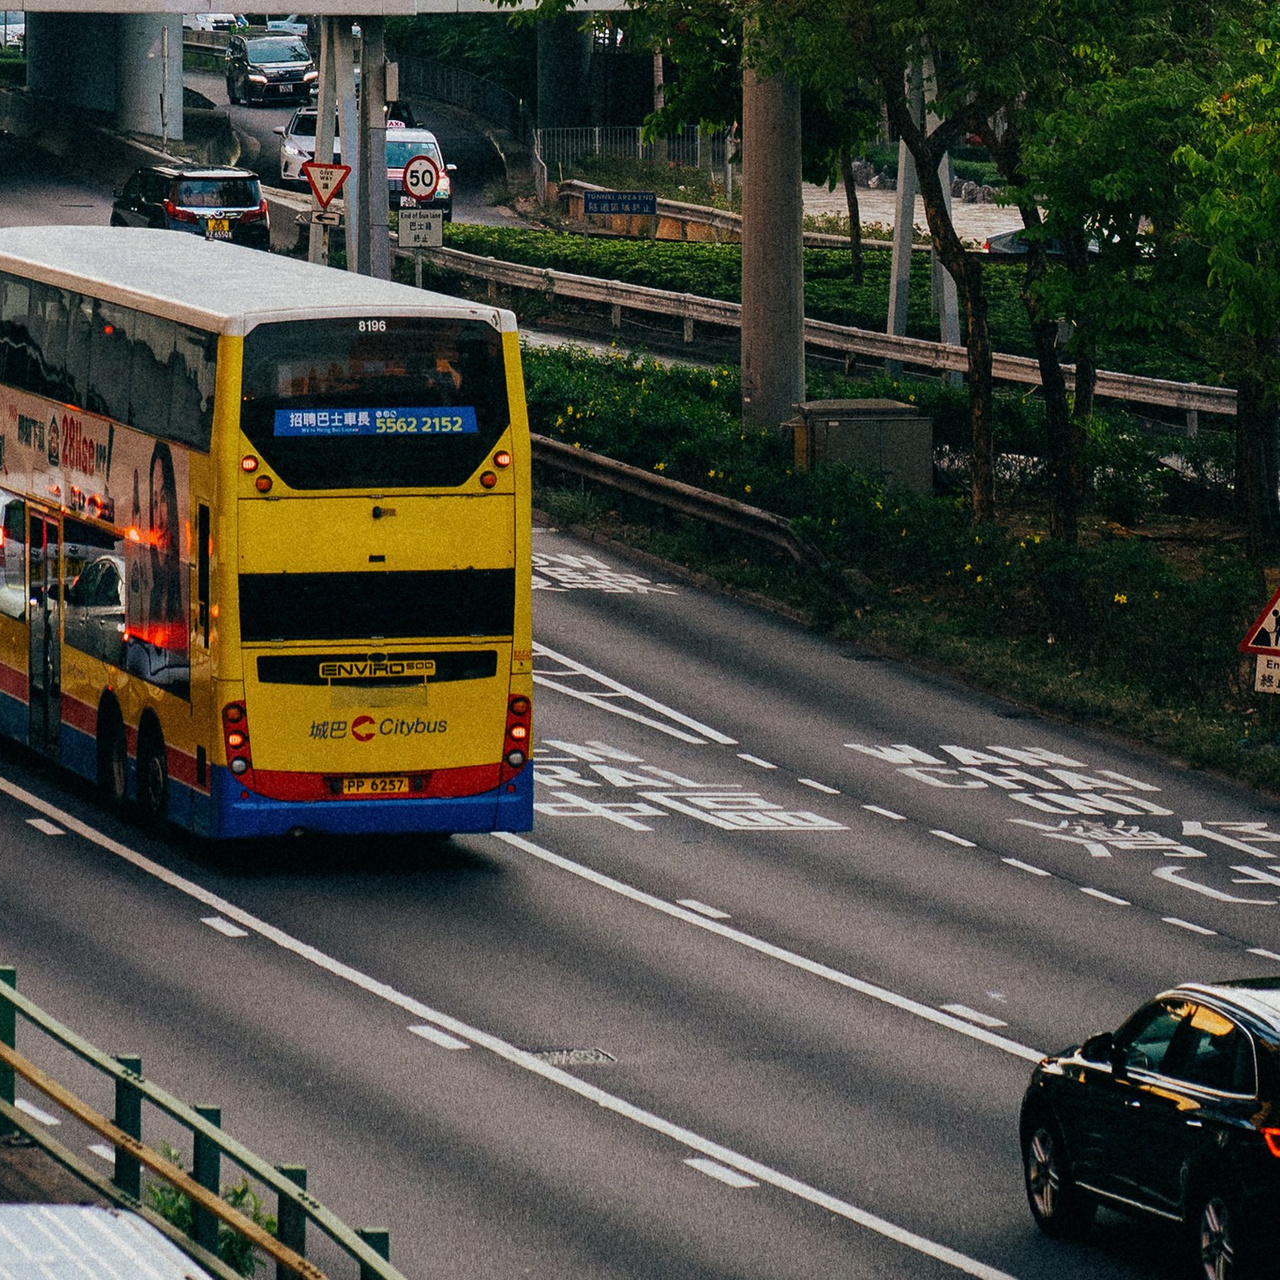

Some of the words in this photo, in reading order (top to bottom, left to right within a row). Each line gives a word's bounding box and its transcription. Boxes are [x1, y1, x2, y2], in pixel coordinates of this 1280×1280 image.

[409, 169, 434, 188] 50
[359, 320, 386, 331] 8196
[289, 412, 370, 428] 招聘巴士車長
[375, 418, 417, 433] 5562
[421, 416, 463, 432] 2152
[1266, 659, 1280, 670] En
[310, 720, 347, 739] 城巴
[379, 717, 447, 736] Citybus
[843, 743, 1089, 767] WAN
[347, 779, 365, 791] PP
[370, 778, 404, 791] 6257
[895, 767, 1162, 791] CHAI
[1008, 793, 1175, 816] (N)
